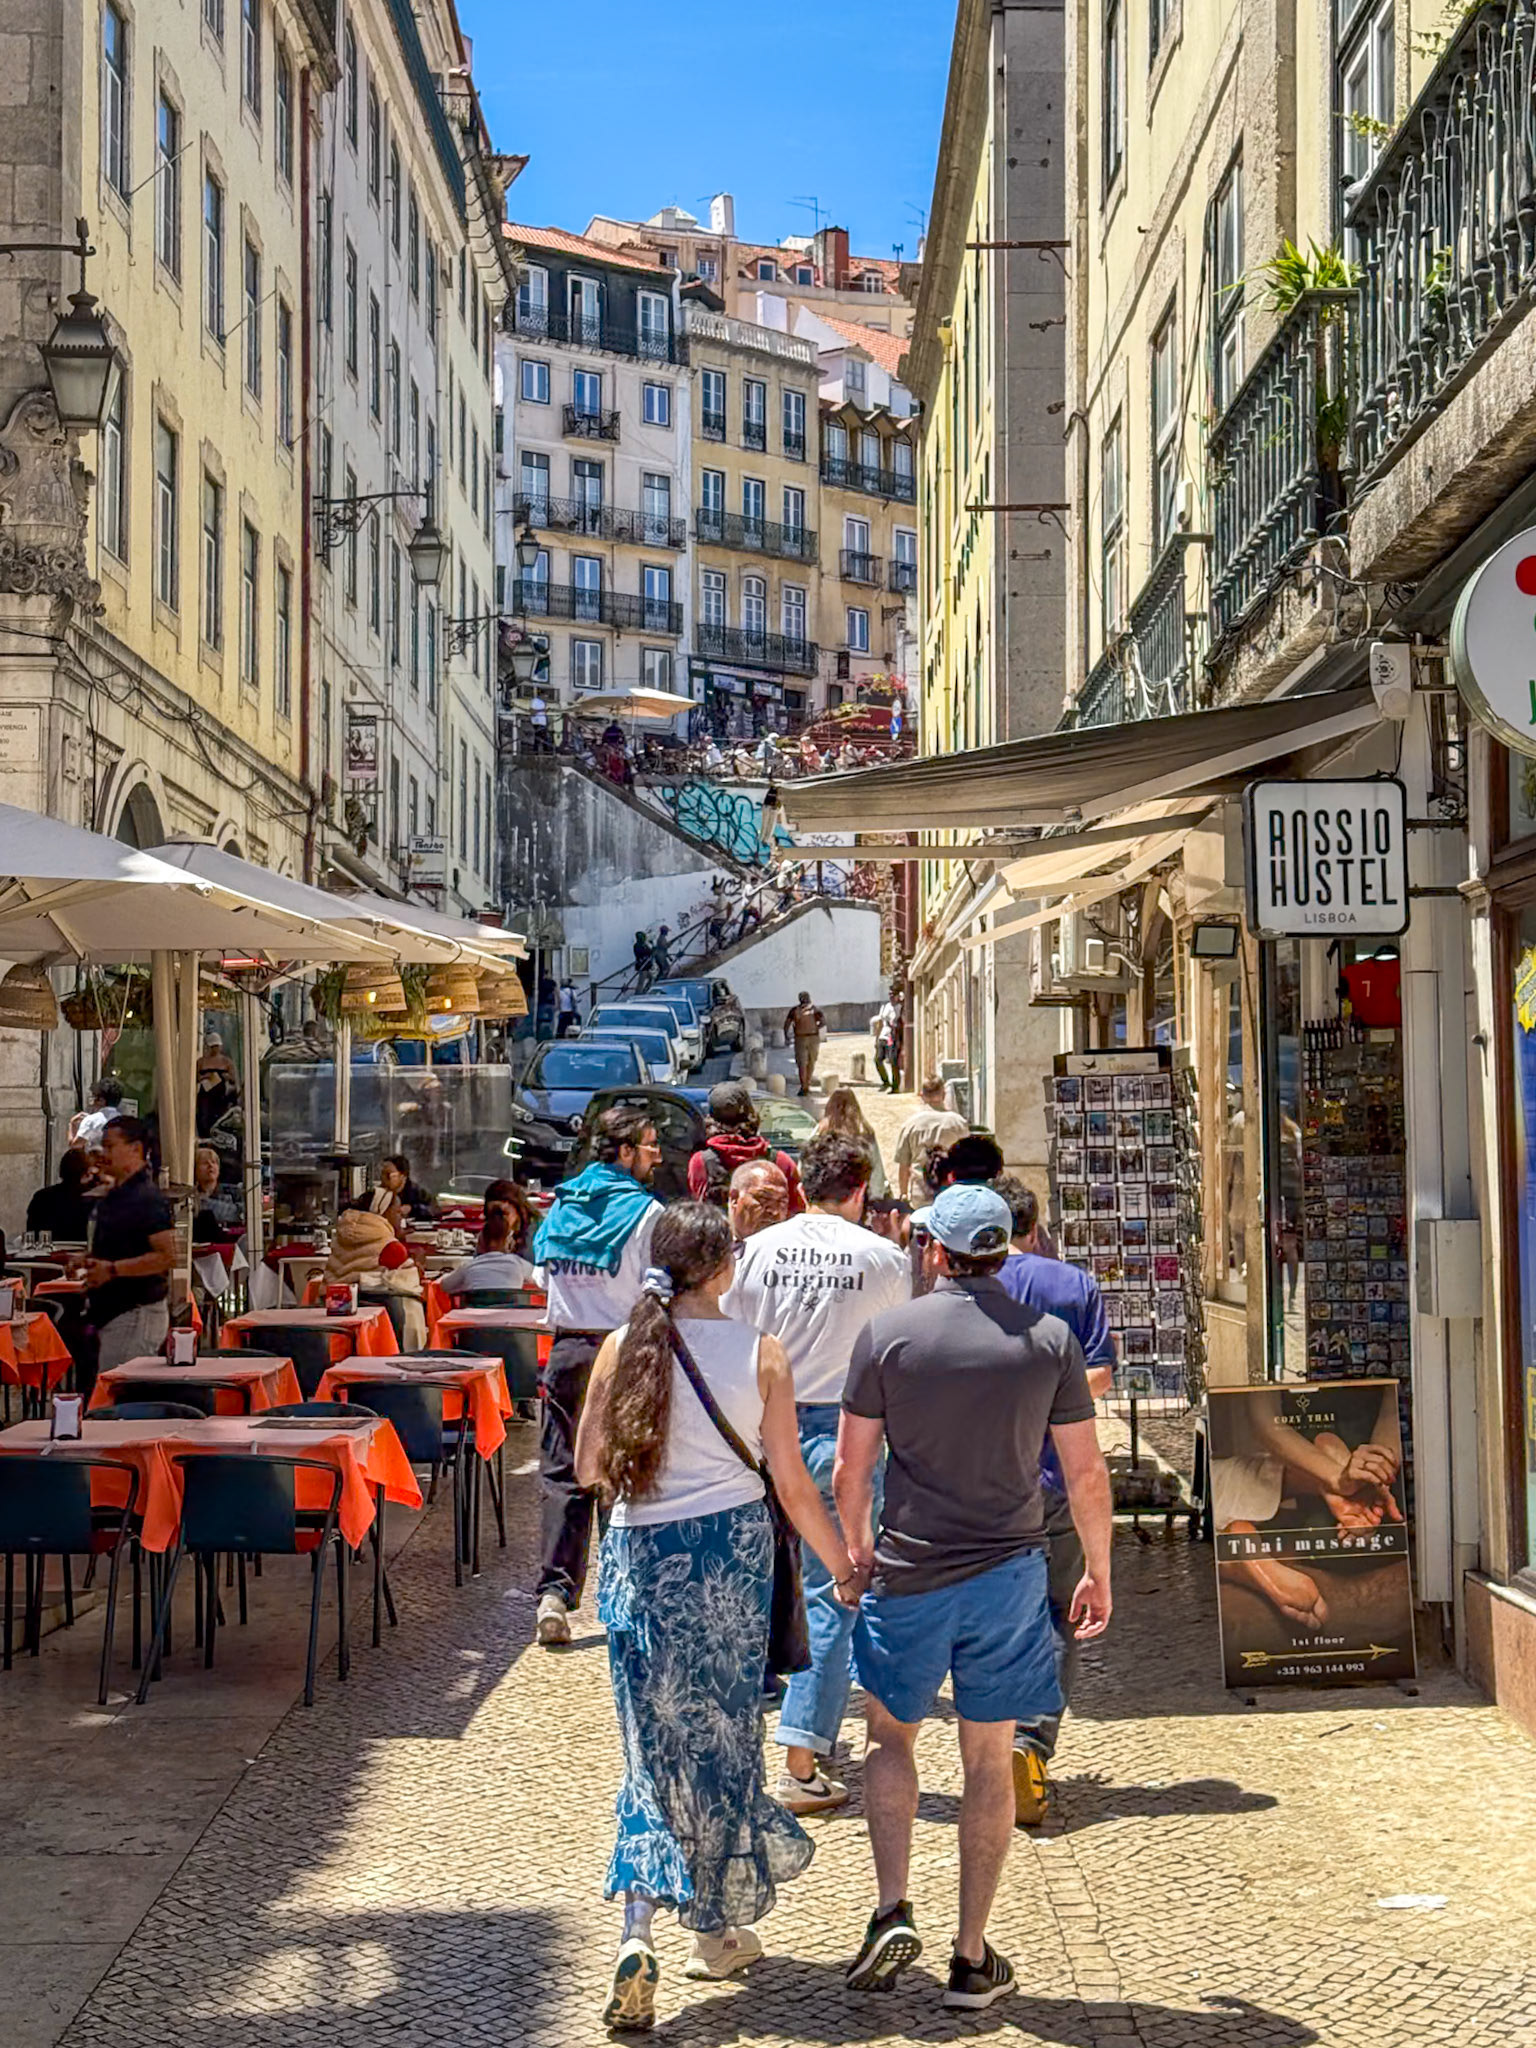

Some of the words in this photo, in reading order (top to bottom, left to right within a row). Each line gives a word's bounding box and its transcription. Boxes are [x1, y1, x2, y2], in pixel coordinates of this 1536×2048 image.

[1269, 808, 1391, 858] ROSSIO
[1270, 857, 1398, 907] HOSTEL
[1304, 912, 1357, 925] LISBOA
[1361, 979, 1371, 998] 7
[775, 1247, 853, 1266] Silbon
[763, 1269, 865, 1292] Original
[1273, 1414, 1302, 1424] COZY
[1307, 1412, 1335, 1422] THAI
[1228, 1537, 1282, 1554] Thai
[1295, 1534, 1395, 1551] massage
[1291, 1638, 1309, 1646] 1st
[1314, 1636, 1345, 1646] floor
[1303, 1664, 1322, 1674] 963
[1325, 1664, 1344, 1673] 144
